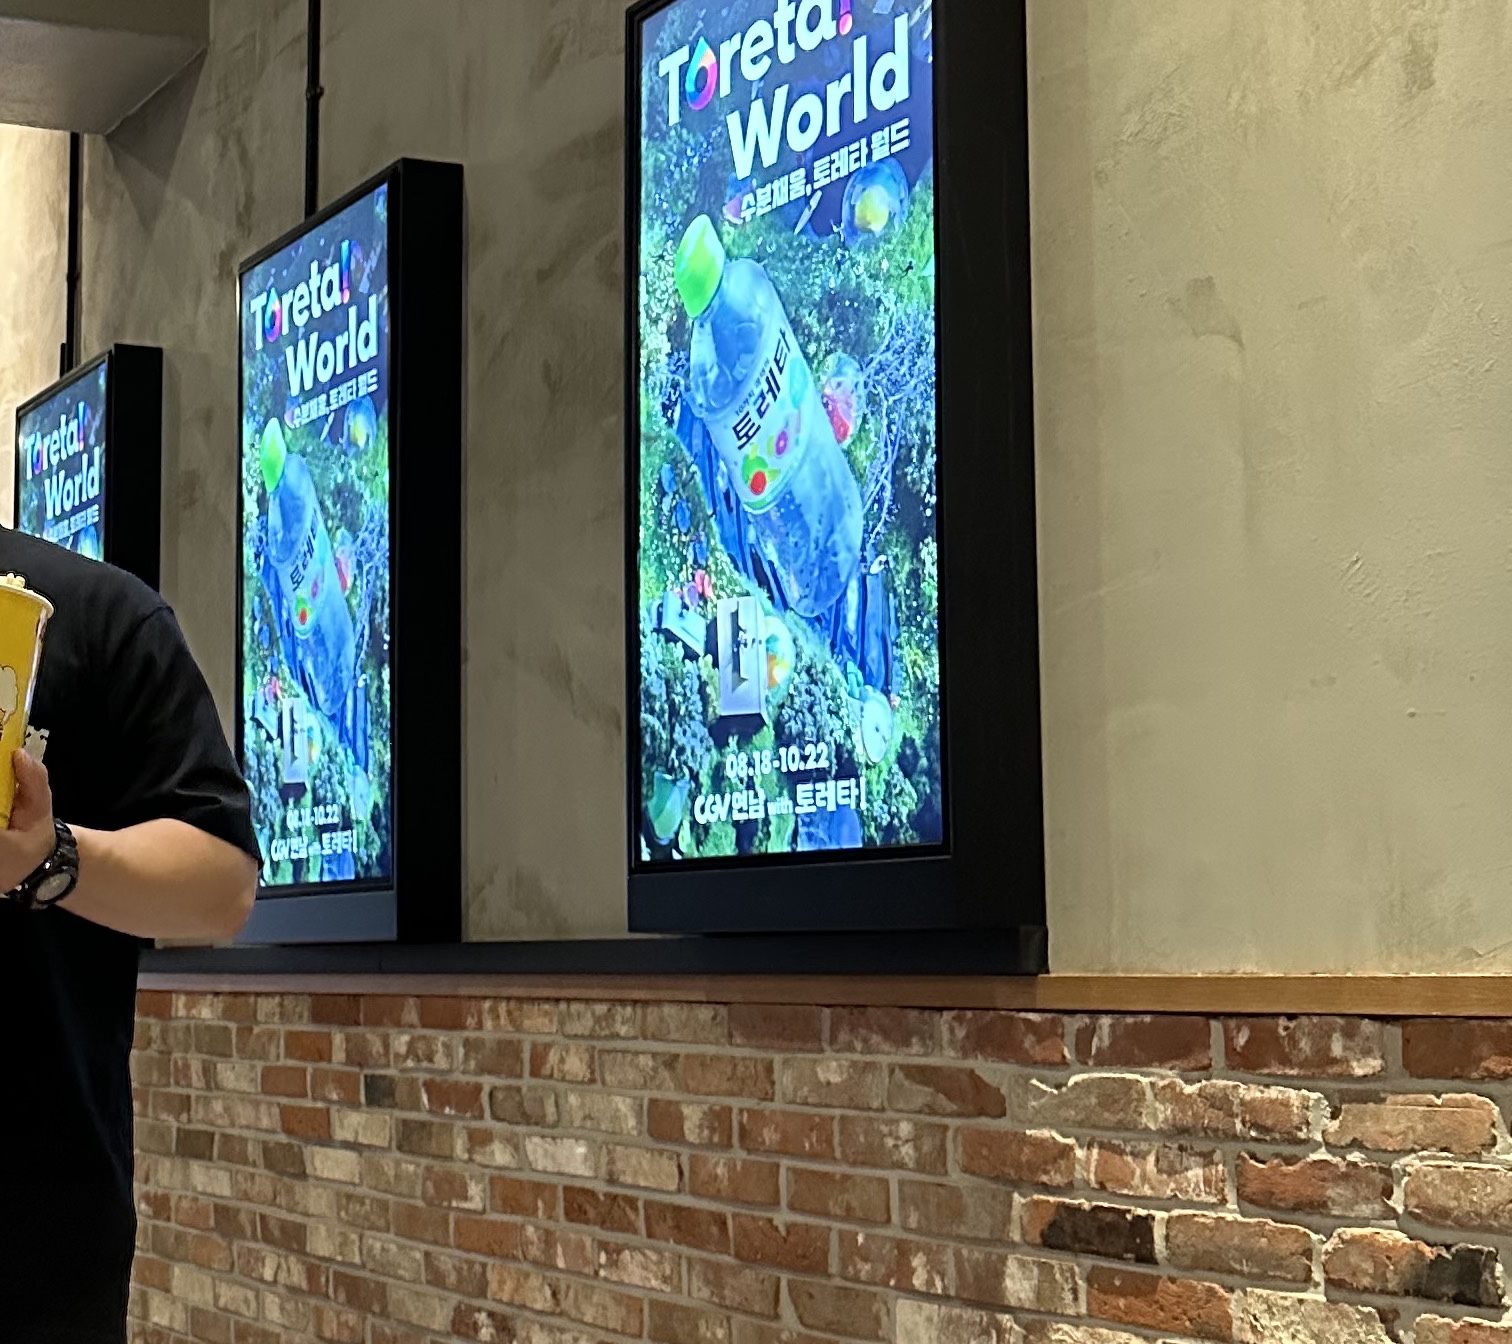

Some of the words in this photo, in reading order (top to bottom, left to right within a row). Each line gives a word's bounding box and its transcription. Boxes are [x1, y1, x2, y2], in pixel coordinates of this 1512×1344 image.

[726, 12, 909, 180] World
[813, 138, 868, 189] 토레타
[871, 117, 910, 162] 월드
[250, 239, 350, 351] Toreta!
[285, 294, 378, 397] World
[732, 328, 790, 450] 토레타
[24, 401, 84, 480] Toreta!
[44, 446, 99, 519] World
[726, 742, 830, 779] 08.18-10.22
[795, 777, 866, 814] 토레타!
